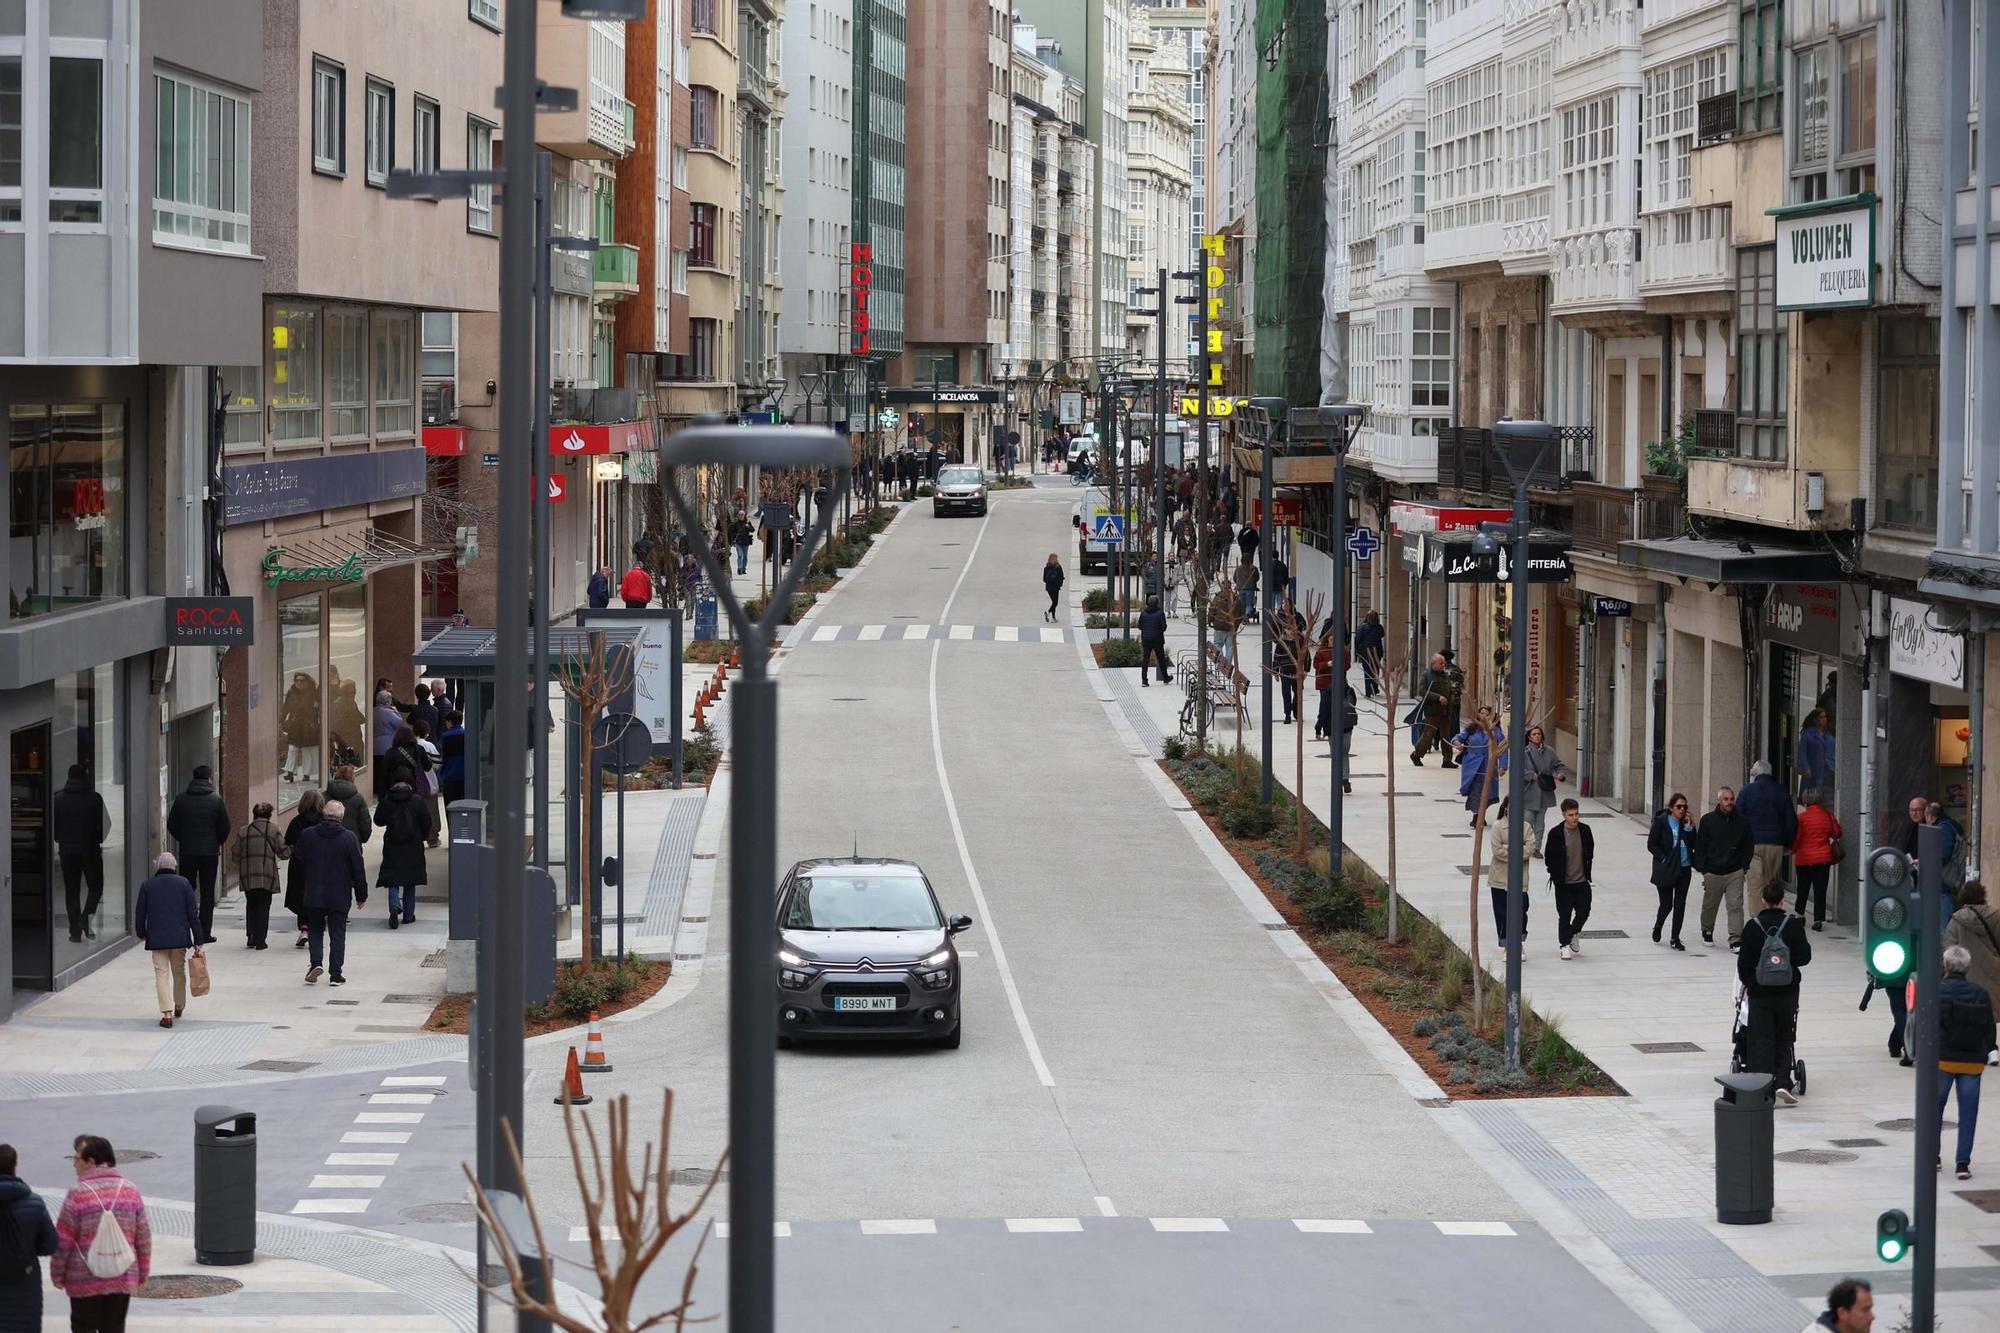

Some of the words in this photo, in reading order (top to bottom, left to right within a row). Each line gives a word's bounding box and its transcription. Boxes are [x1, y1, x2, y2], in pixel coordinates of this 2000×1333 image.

[1791, 222, 1852, 264] VOLUMEN
[1819, 268, 1866, 295] PELUQUERIA
[262, 548, 365, 588] Garrote
[1449, 559, 1463, 575] La
[176, 607, 241, 626] ROCA
[842, 999, 868, 1009] 8990
[872, 999, 892, 1009] MNT
